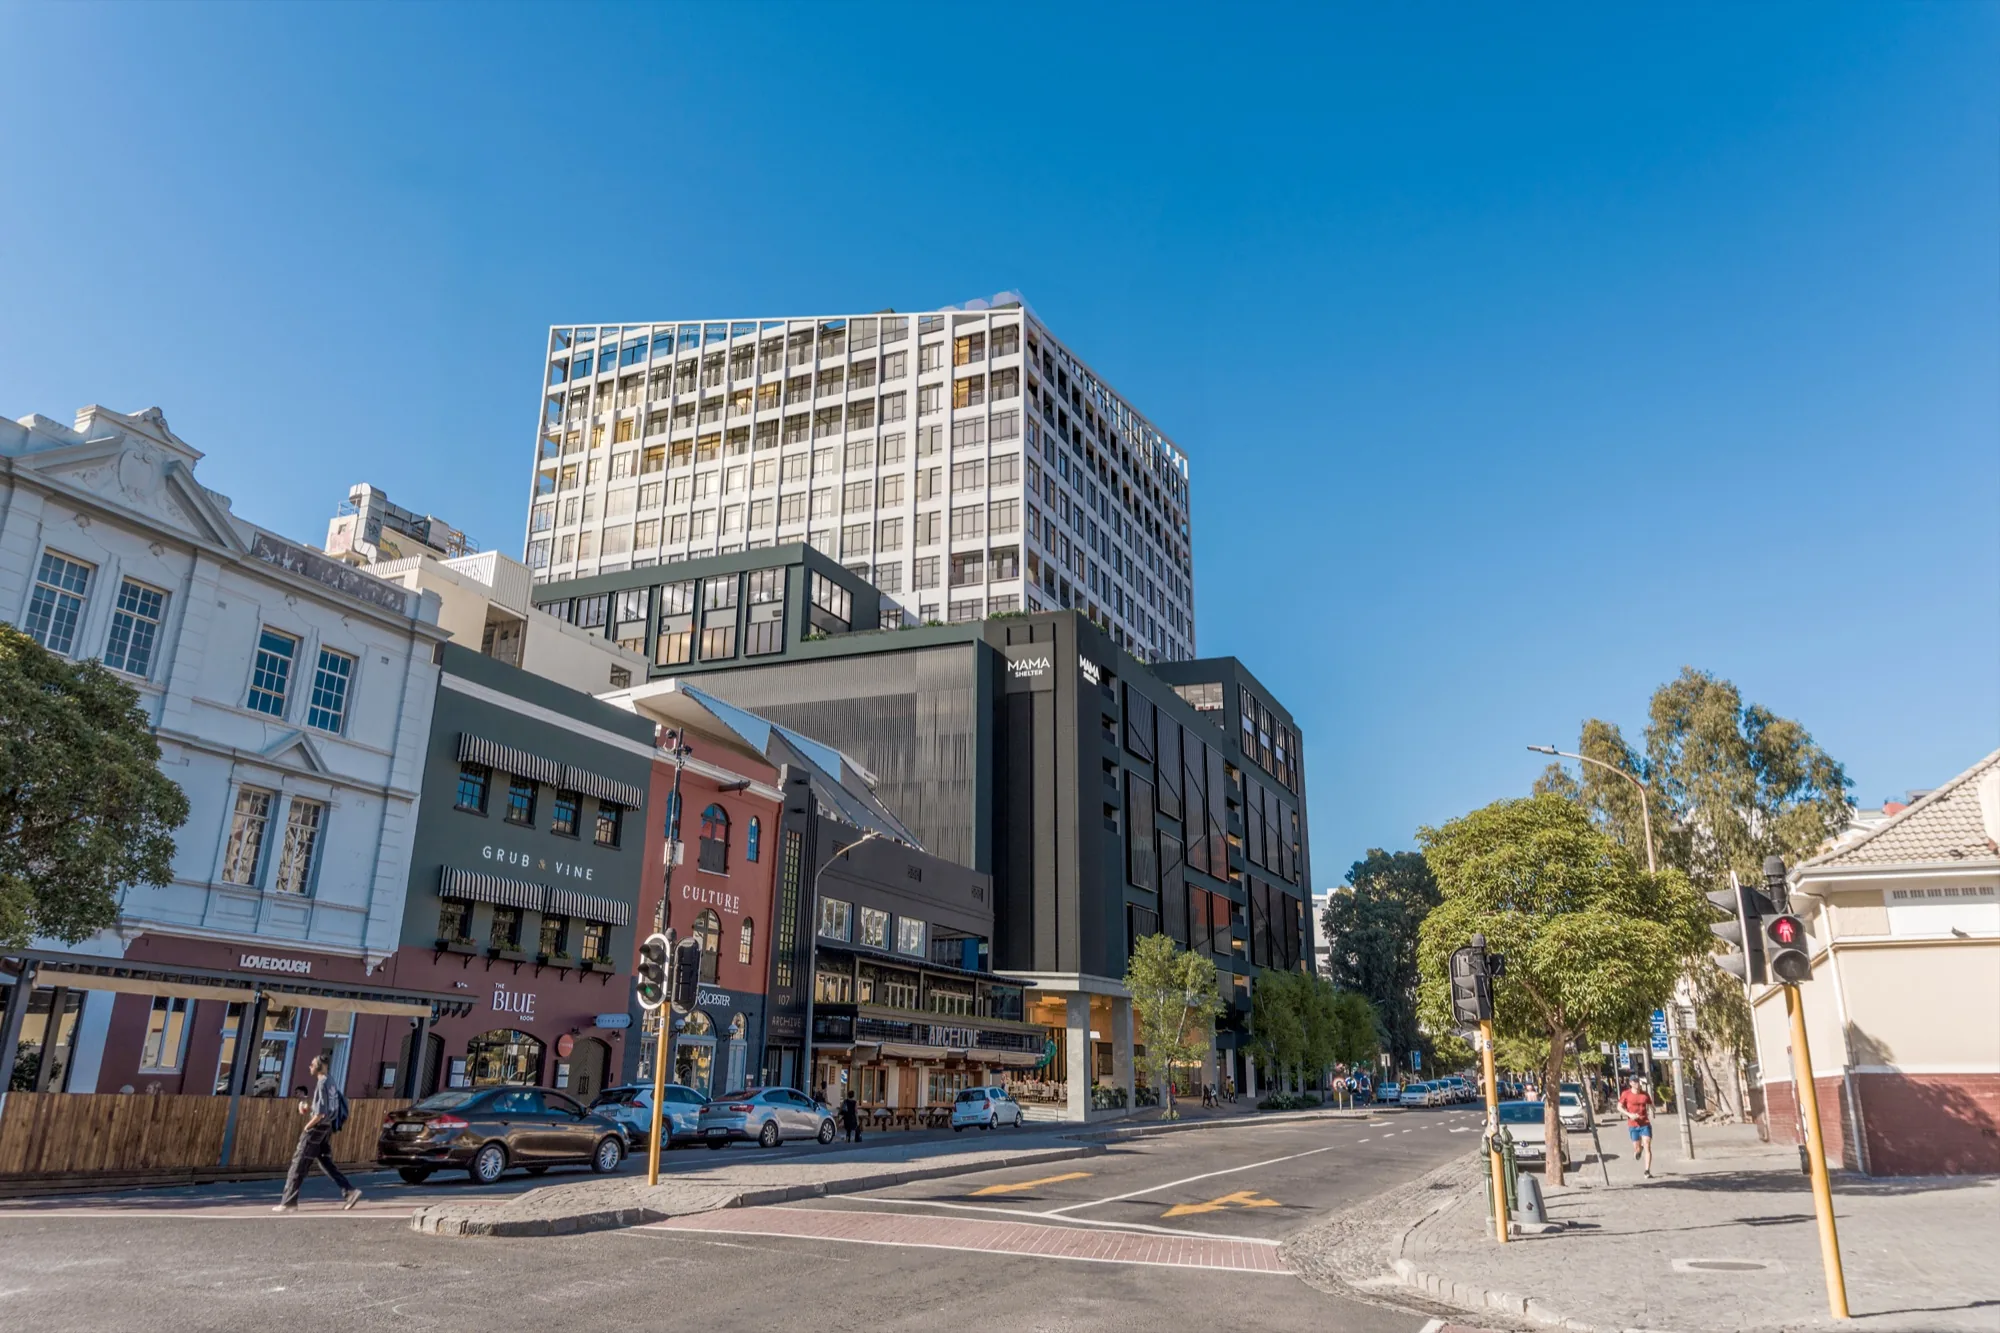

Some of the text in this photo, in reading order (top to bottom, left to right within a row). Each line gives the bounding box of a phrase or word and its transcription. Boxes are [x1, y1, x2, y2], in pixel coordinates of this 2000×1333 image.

[1007, 656, 1050, 672] MAMA
[1015, 669, 1043, 678] SHELTER
[1079, 654, 1100, 680] MAMA
[482, 846, 530, 867] GRUB
[555, 861, 593, 881] VINE
[682, 885, 739, 909] CULTURE
[240, 954, 312, 973] LOVEDOUGH
[492, 990, 536, 1013] BLUE
[778, 994, 791, 1006] 107
[771, 1015, 802, 1028] ARCHIVE
[928, 1024, 979, 1047] ARCHIVE
